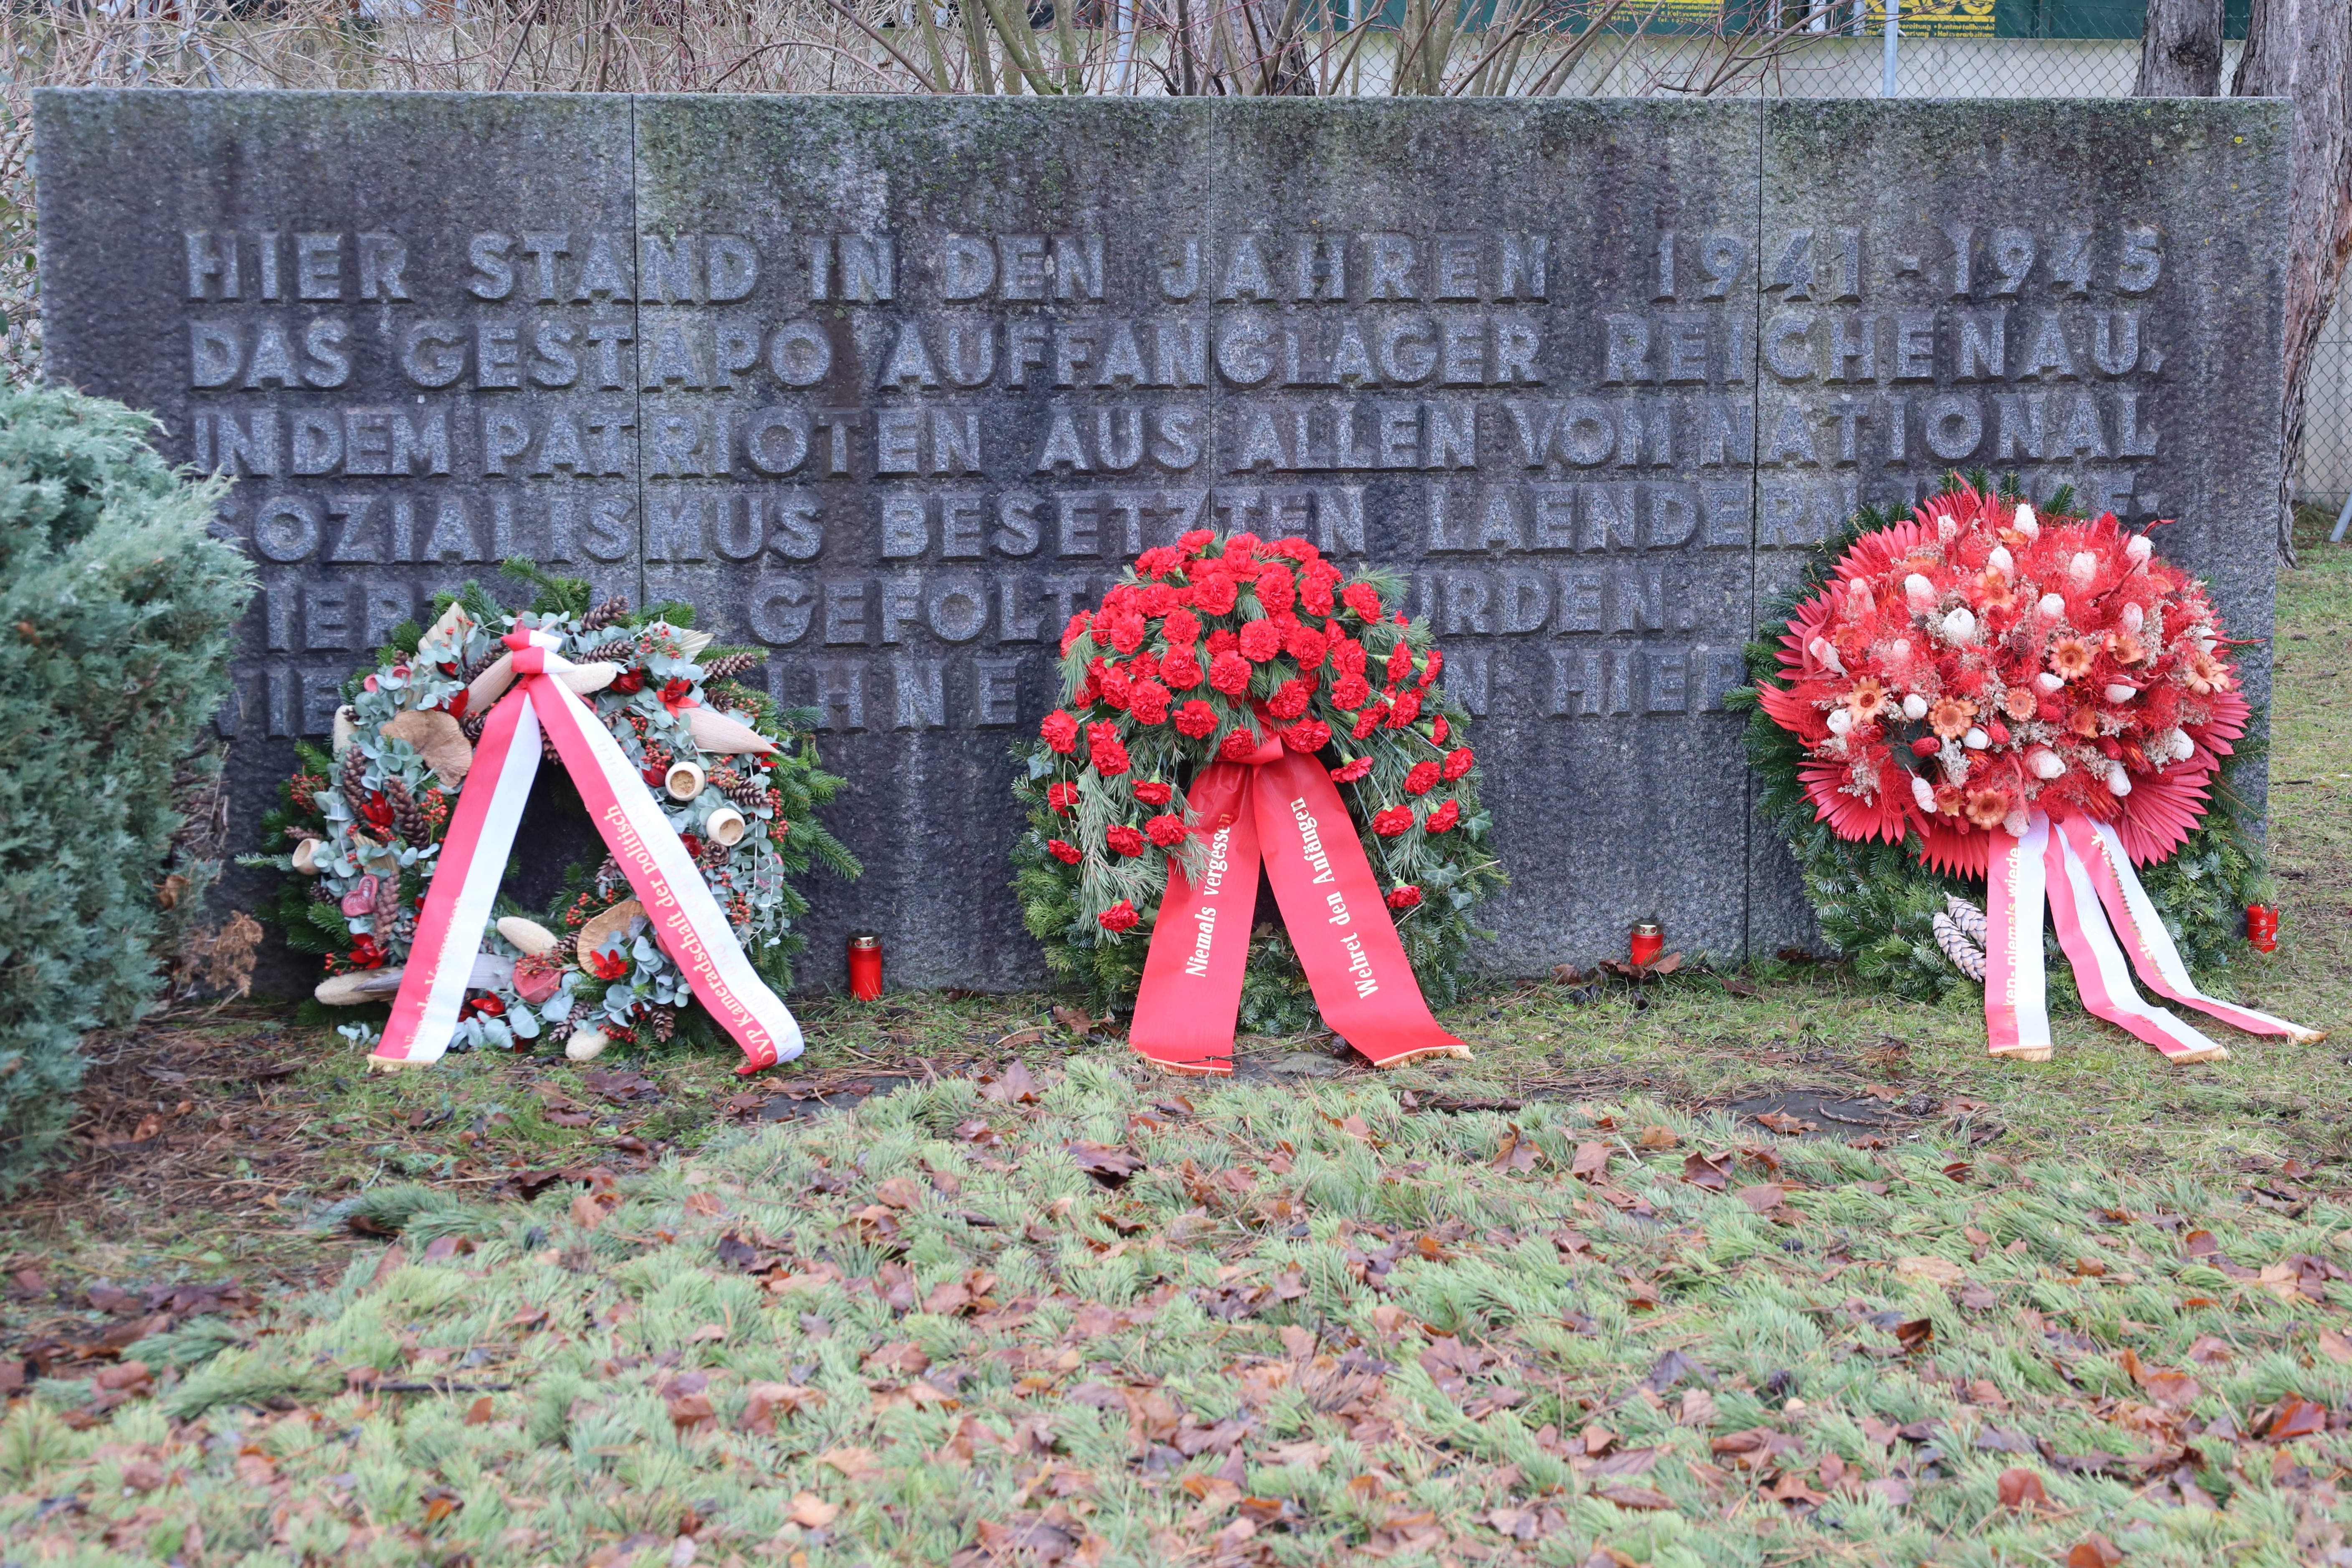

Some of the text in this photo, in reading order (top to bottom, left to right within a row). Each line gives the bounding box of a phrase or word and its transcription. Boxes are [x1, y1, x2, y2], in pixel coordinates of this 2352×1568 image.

[186, 232, 415, 304] HIER
[466, 232, 758, 306] STAND
[808, 233, 894, 306] IN
[943, 232, 1106, 306] DEN
[1159, 231, 1551, 305] JAHREN
[1649, 227, 1861, 304] 1941
[1943, 224, 2166, 301] 1945
[187, 309, 2166, 392] DAS GESTAPO AUFFANGLAGER REICHENAU,
[483, 405, 982, 479] PATRIOTEN
[1030, 403, 1204, 477] AUS
[1232, 401, 1478, 473] ALLEN
[1506, 399, 1671, 472] VOM
[1699, 392, 2160, 471] NATIONAL
[877, 488, 1366, 564] BESETZTEN
[748, 573, 1121, 649] GEFOLT
[594, 741, 650, 828] Österreich
[1185, 813, 1234, 978] Niemals vergessen
[1289, 796, 1379, 999] Wehret den Anfängen
[2004, 842, 2022, 899] wieder
[402, 896, 467, 1050] Niemals Vergessen
[603, 803, 775, 1065] ÖVP Kameradschaft der politisch
[709, 942, 737, 976] und
[2003, 902, 2018, 968] niemals
